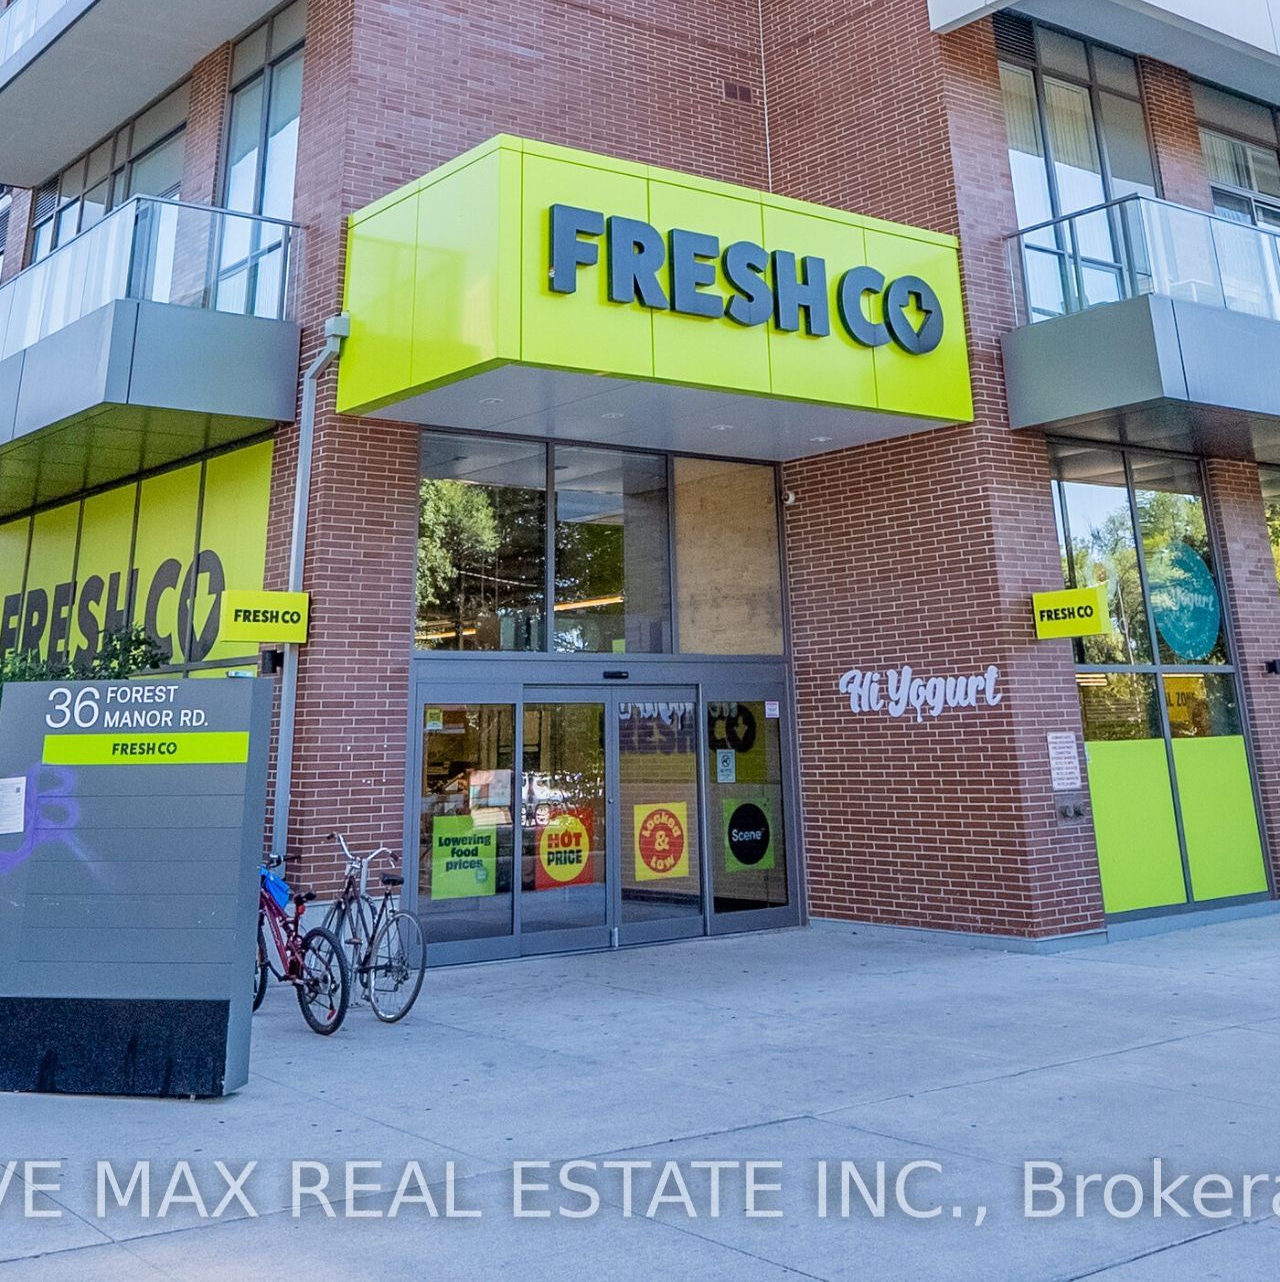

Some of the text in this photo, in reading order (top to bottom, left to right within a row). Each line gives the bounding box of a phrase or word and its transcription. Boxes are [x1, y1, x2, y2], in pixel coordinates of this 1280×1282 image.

[549, 203, 945, 356] FRESH CO
[145, 549, 226, 663] CO
[1039, 605, 1094, 622] FRESH CO
[234, 609, 301, 624] FRESH CO
[839, 665, 1002, 723] Hi Yogurt
[45, 685, 178, 729] 36 FOREST
[104, 709, 209, 728] MANOR RD.
[112, 742, 178, 756] FRESH CO
[438, 834, 491, 847] Lowering
[547, 830, 582, 848] HOT
[654, 830, 669, 851] &
[732, 828, 762, 842] Scene
[451, 847, 479, 857] food
[547, 849, 582, 866] PRICE
[445, 859, 484, 872] prices
